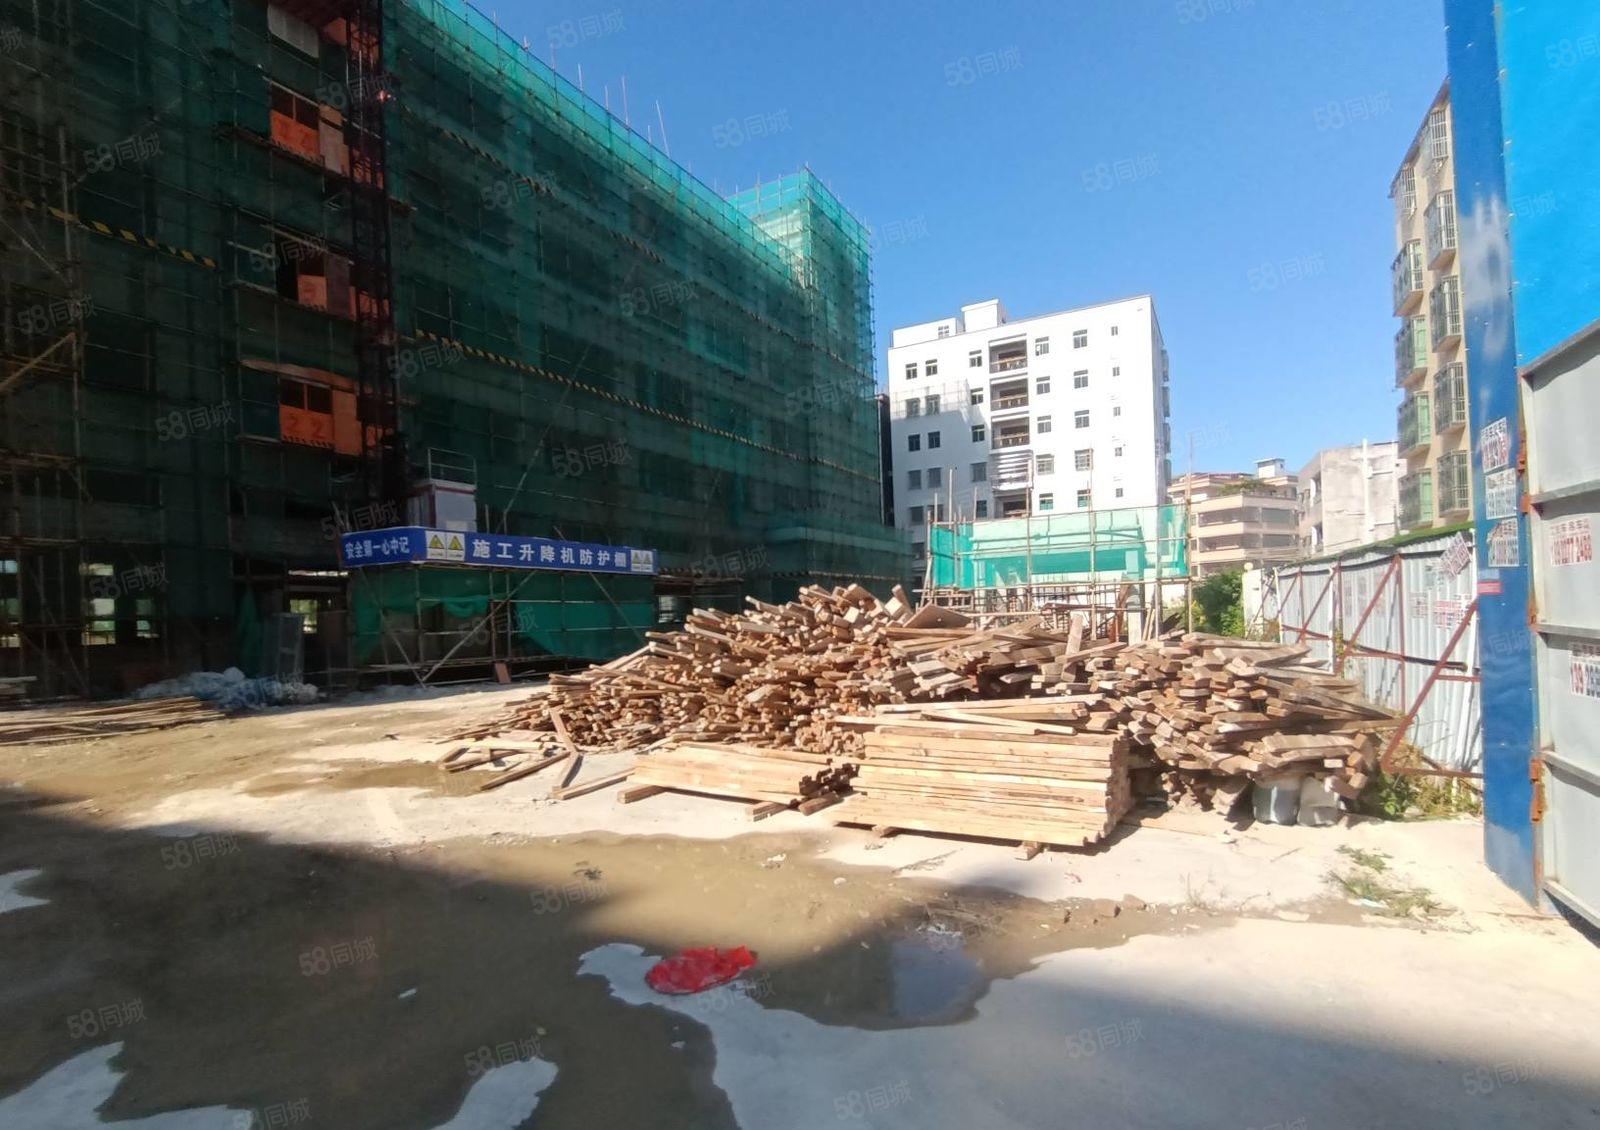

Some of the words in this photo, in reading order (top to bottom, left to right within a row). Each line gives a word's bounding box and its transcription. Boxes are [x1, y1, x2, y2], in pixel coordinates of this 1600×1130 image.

[472, 539, 627, 567] 施工升降机防护棚
